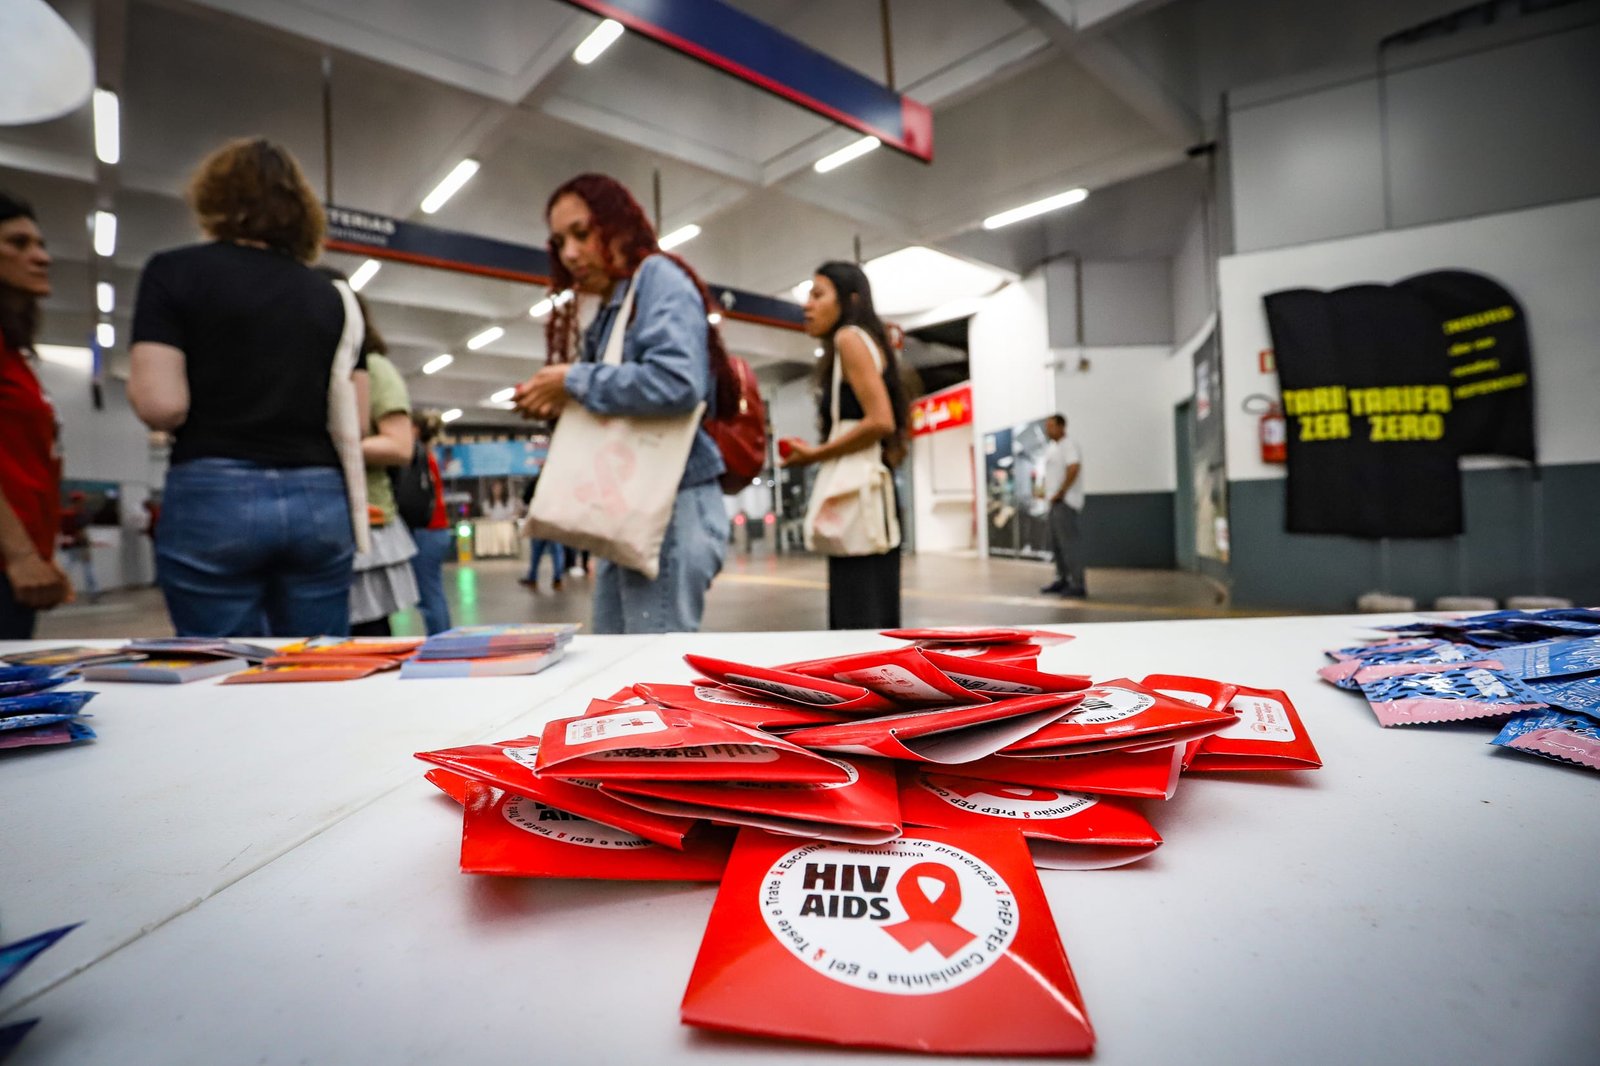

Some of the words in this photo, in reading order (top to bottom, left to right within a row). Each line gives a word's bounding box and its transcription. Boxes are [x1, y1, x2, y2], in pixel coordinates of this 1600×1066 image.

[1349, 385, 1452, 416] TARIFA
[1368, 413, 1444, 441] ZERO
[950, 798, 978, 810] PEP
[981, 807, 1016, 816] PrEP
[779, 843, 827, 870] Escolha
[935, 846, 998, 888] prevenção
[803, 863, 891, 893] HIV
[766, 880, 781, 906] Trate
[799, 894, 891, 921] AIDS
[997, 899, 1013, 926] PrEP
[778, 920, 810, 953] Teste
[985, 927, 1008, 952] PEP
[828, 959, 861, 976] gel
[868, 970, 878, 980] e
[888, 953, 985, 988] Camisinha
